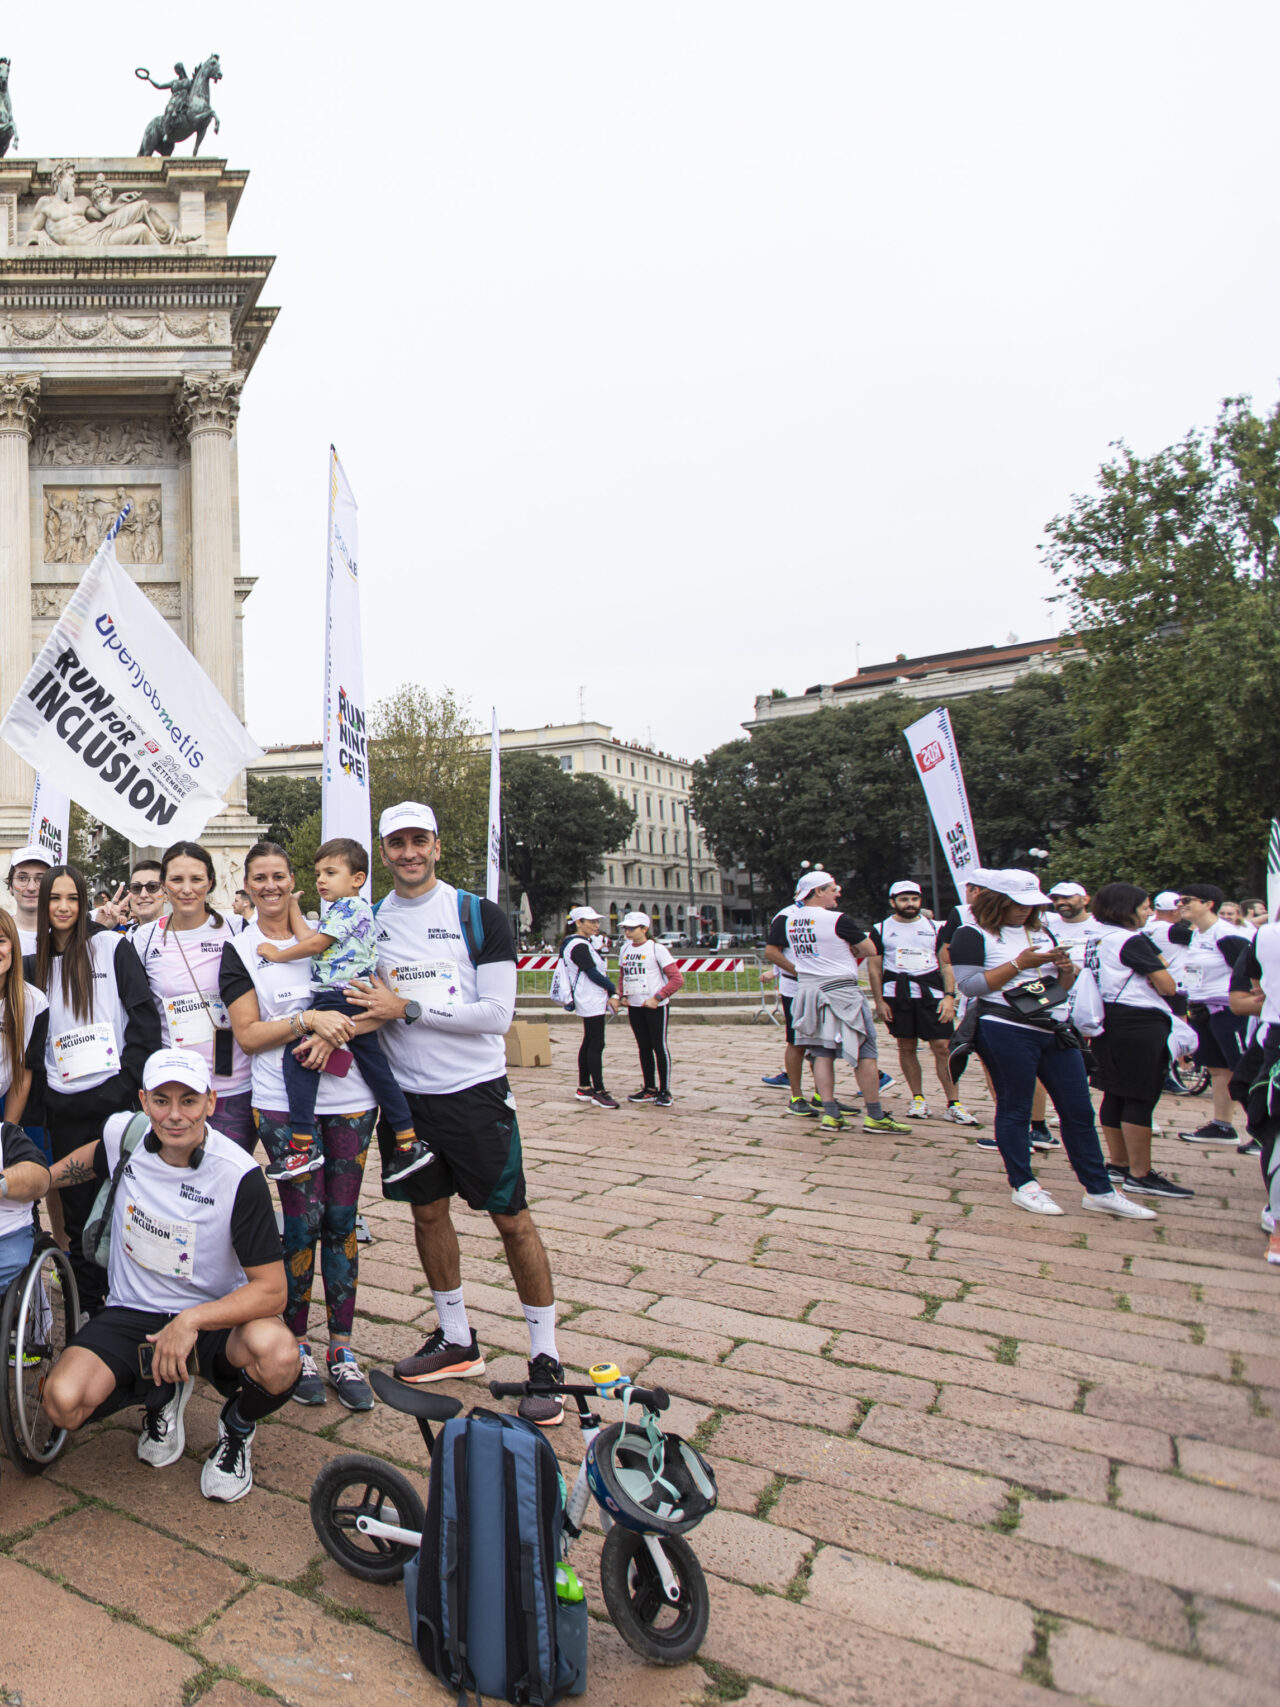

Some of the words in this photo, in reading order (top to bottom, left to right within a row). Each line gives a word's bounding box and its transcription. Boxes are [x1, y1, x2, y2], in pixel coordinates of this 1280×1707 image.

[54, 647, 115, 715] RUN
[100, 710, 136, 748] FOR
[338, 690, 366, 734] RUN
[27, 670, 178, 826] INCLUSION
[152, 761, 186, 798] SETTEMBRE
[40, 818, 62, 842] RUN
[38, 834, 62, 854] NING
[397, 970, 436, 981] INCLUSION
[174, 1001, 210, 1014] INCLUSION
[60, 1034, 71, 1042] RUN
[60, 1034, 96, 1050] INCLUSION
[181, 1183, 195, 1193] RUN
[180, 1190, 215, 1206] INCLUSION
[133, 1205, 145, 1218] RUN
[132, 1213, 170, 1239] INCLUSION
